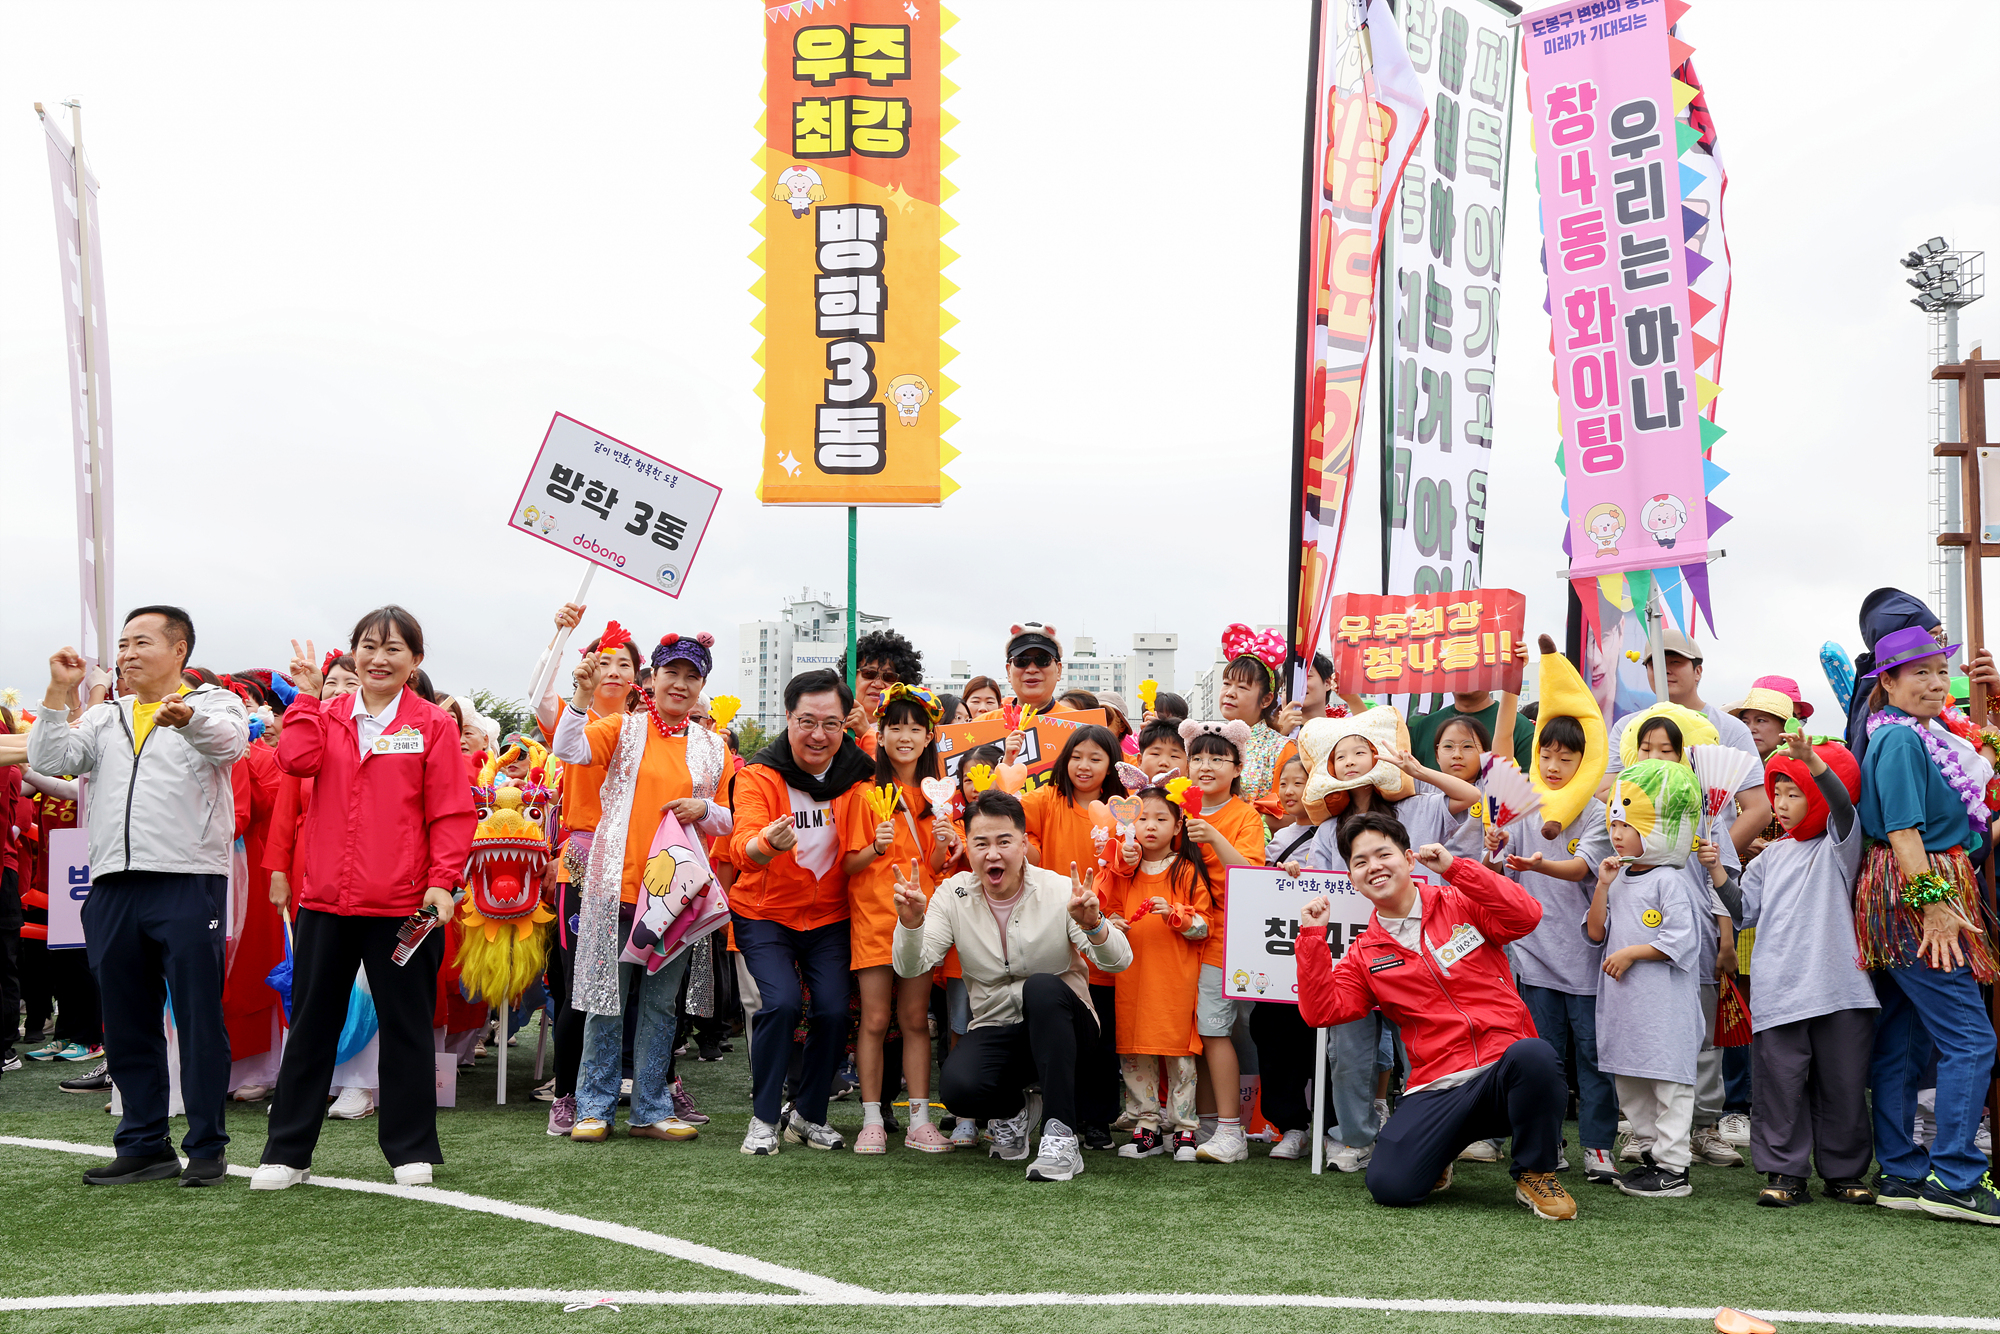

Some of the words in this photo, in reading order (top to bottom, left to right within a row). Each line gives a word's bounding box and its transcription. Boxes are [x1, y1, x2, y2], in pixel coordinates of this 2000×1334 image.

[1531, 11, 1574, 38] 도봉구
[1577, 0, 1621, 24] 변화의
[1543, 30, 1586, 55] 미래가
[1590, 13, 1647, 41] 기대되는
[793, 23, 911, 87] 우주
[792, 96, 911, 159] 최강
[1546, 80, 1608, 273] 창4동
[1610, 99, 1670, 291] 우리는
[814, 205, 888, 475] 방학3동
[1564, 286, 1625, 475] 화이팅
[1624, 305, 1685, 431] 하나
[593, 440, 611, 456] 같이
[613, 450, 631, 469] 변화,
[635, 458, 662, 481] 행복한
[663, 474, 679, 489] 도봉
[546, 463, 619, 521] 방학
[624, 500, 688, 551] 3동
[572, 533, 626, 568] dobong
[1337, 600, 1484, 646] 우주최강
[1363, 631, 1512, 683] 창4동!!
[393, 742, 418, 750] 강혜란
[1275, 878, 1295, 891] 같이
[1299, 880, 1322, 894] 변화,
[1455, 934, 1479, 954] 이호석
